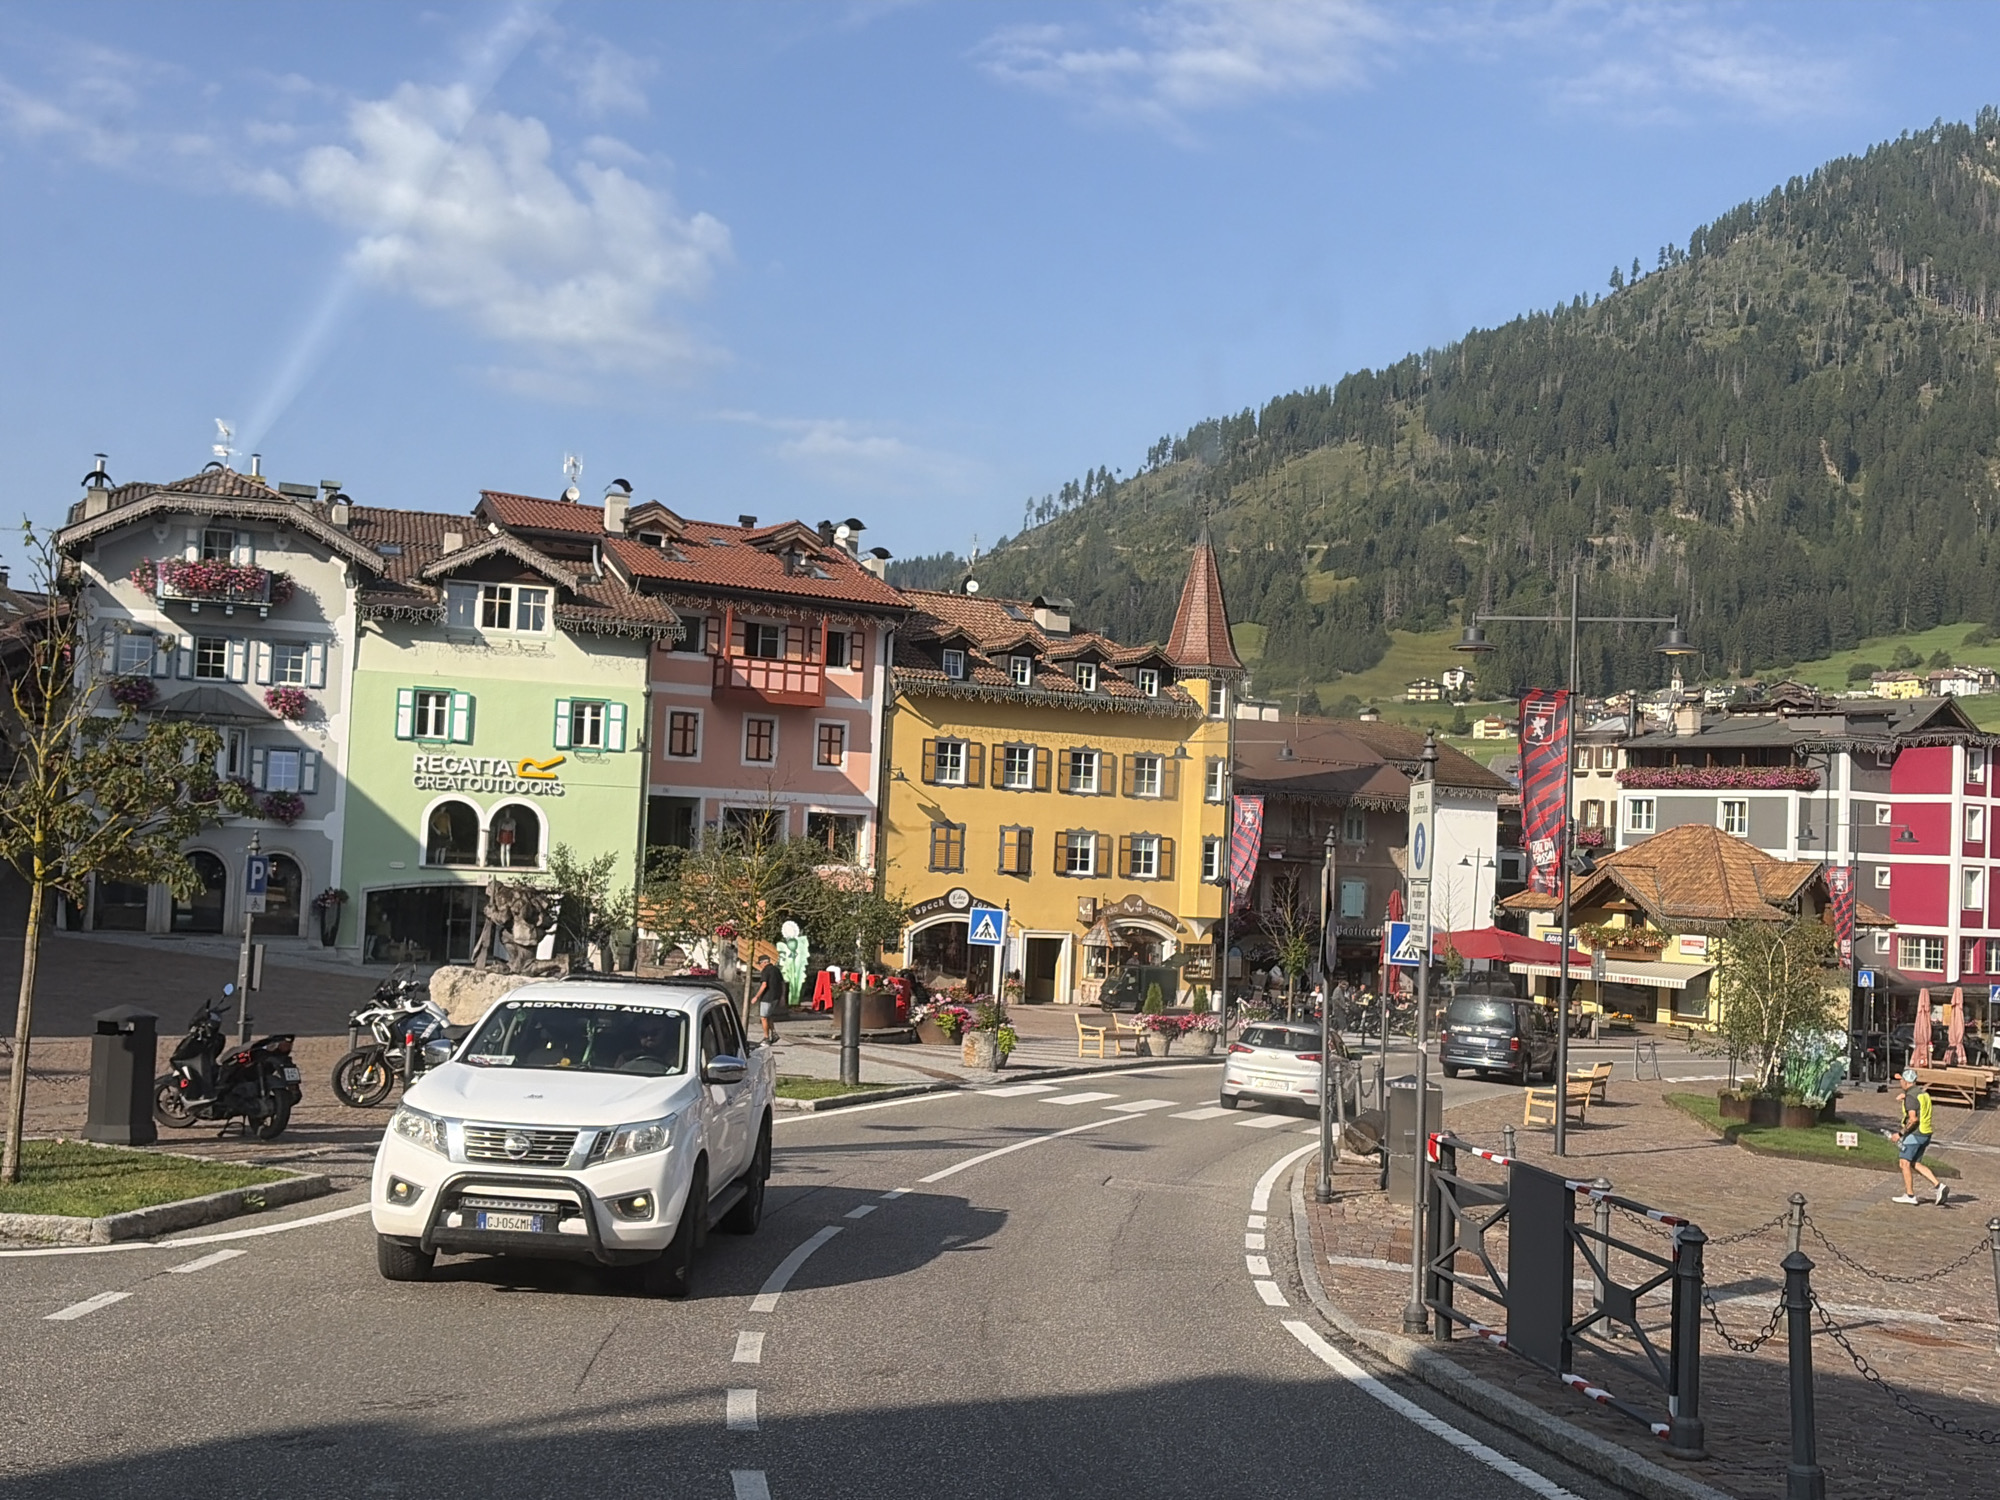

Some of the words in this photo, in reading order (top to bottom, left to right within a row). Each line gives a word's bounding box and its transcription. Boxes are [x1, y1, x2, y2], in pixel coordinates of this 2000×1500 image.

[413, 754, 512, 776] REGATTA
[412, 775, 466, 790] GREAT
[469, 778, 564, 795] OUTDOORS
[251, 860, 264, 889] P
[1147, 907, 1173, 922] DOLOMITI
[522, 1002, 617, 1011] ROTALNORD
[620, 1006, 666, 1015] AUTO
